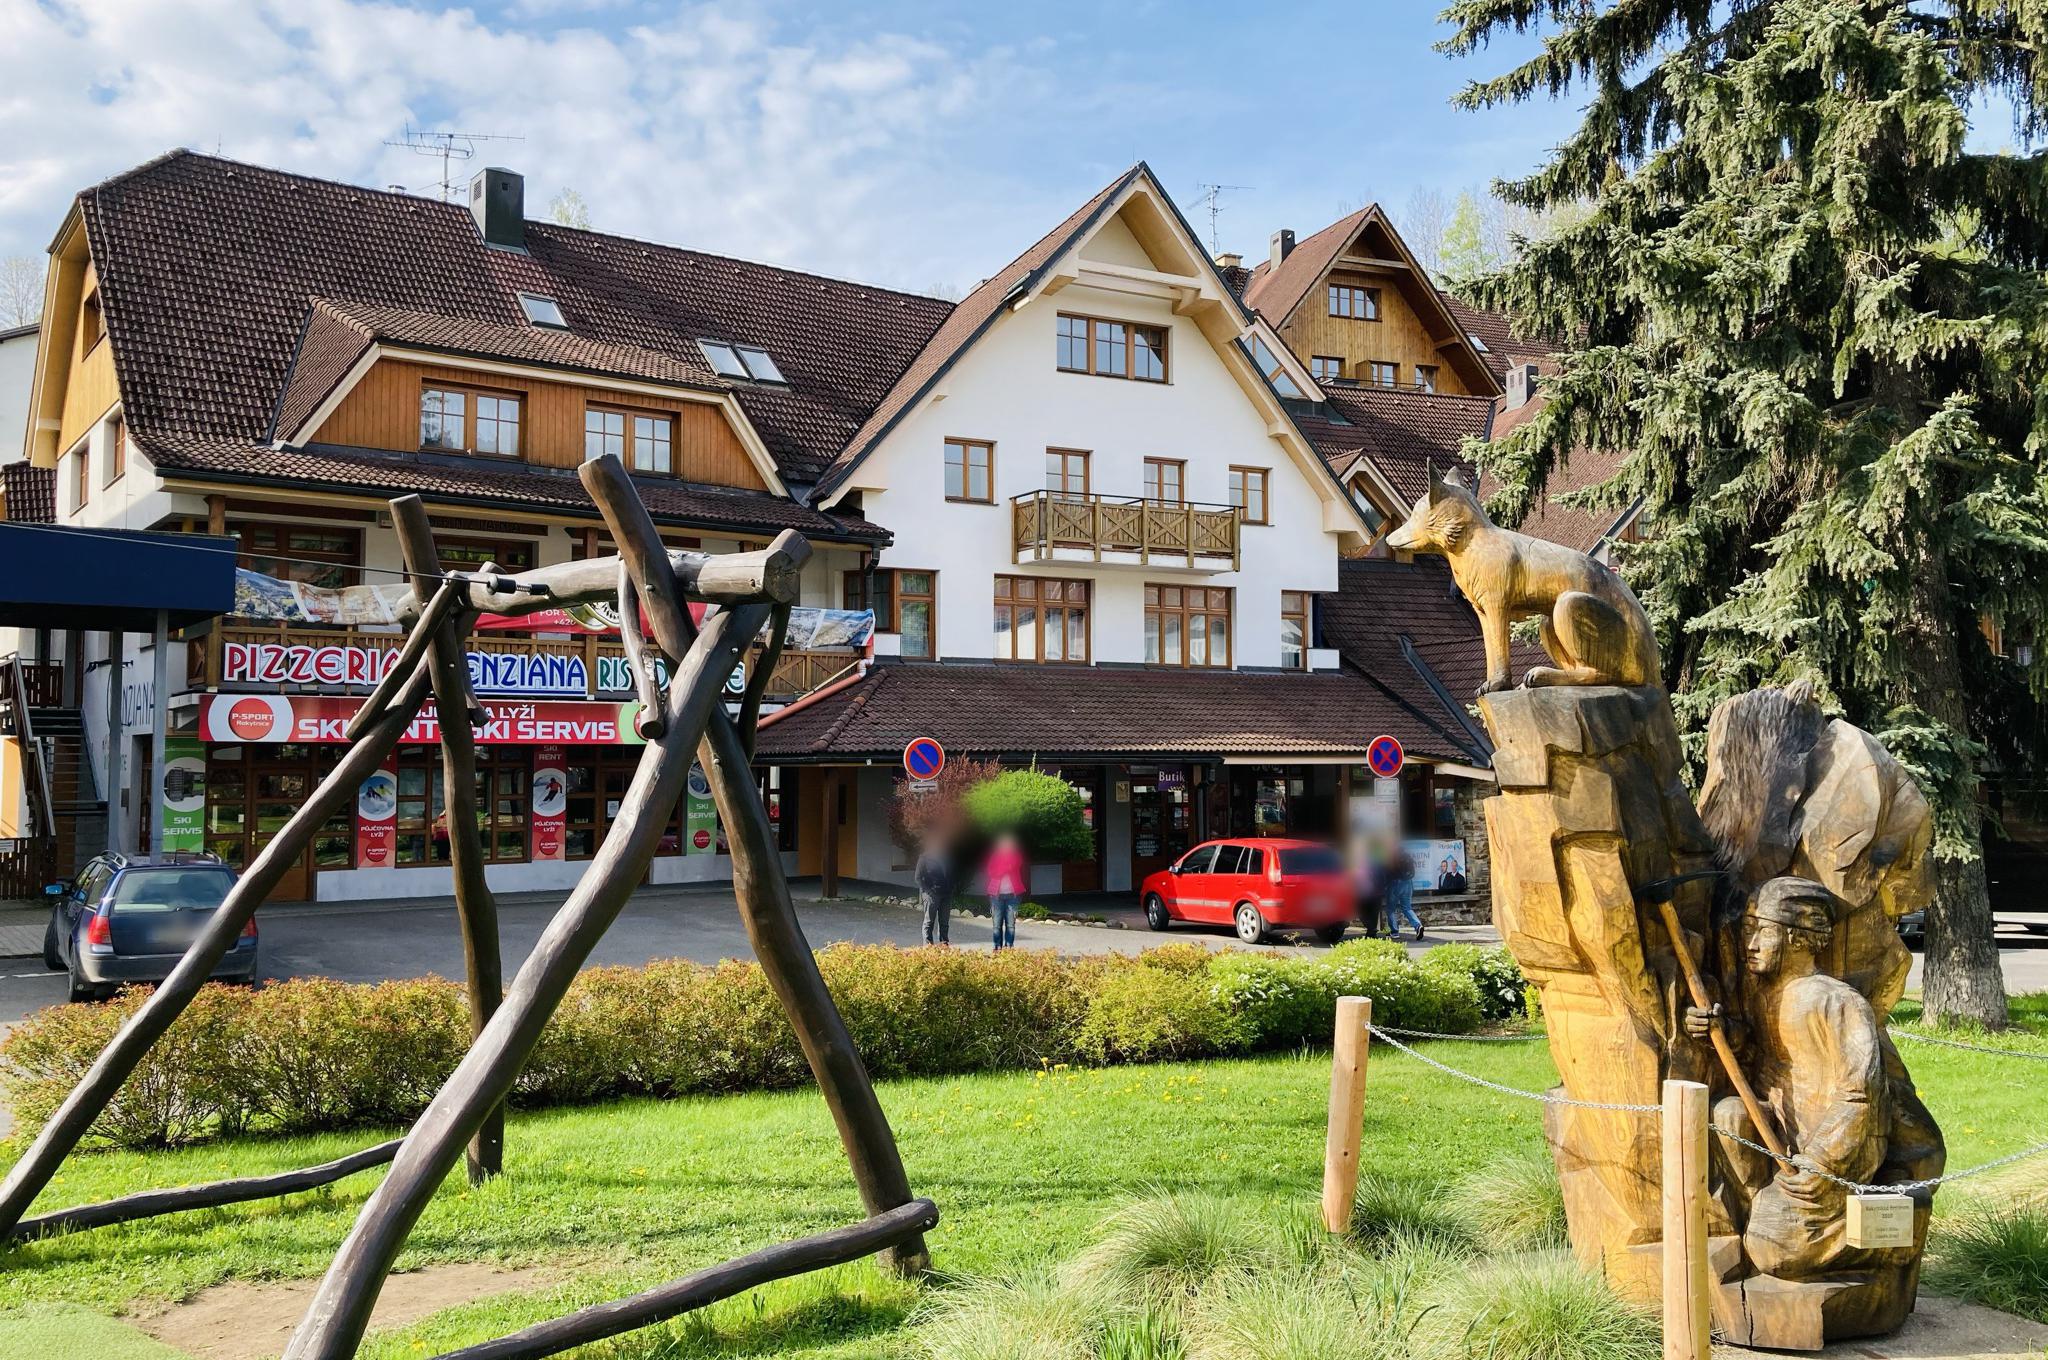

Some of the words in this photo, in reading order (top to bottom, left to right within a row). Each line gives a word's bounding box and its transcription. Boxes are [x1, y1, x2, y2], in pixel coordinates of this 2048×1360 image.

[467, 654, 586, 690] ENZIANA
[232, 713, 275, 721] P-SPORT
[500, 704, 535, 719] LYŽÍ
[298, 719, 348, 739] SKI
[518, 721, 616, 740] SERVIS
[1158, 770, 1185, 782] Butik
[173, 816, 192, 824] SKI
[162, 827, 203, 835] SERVIS
